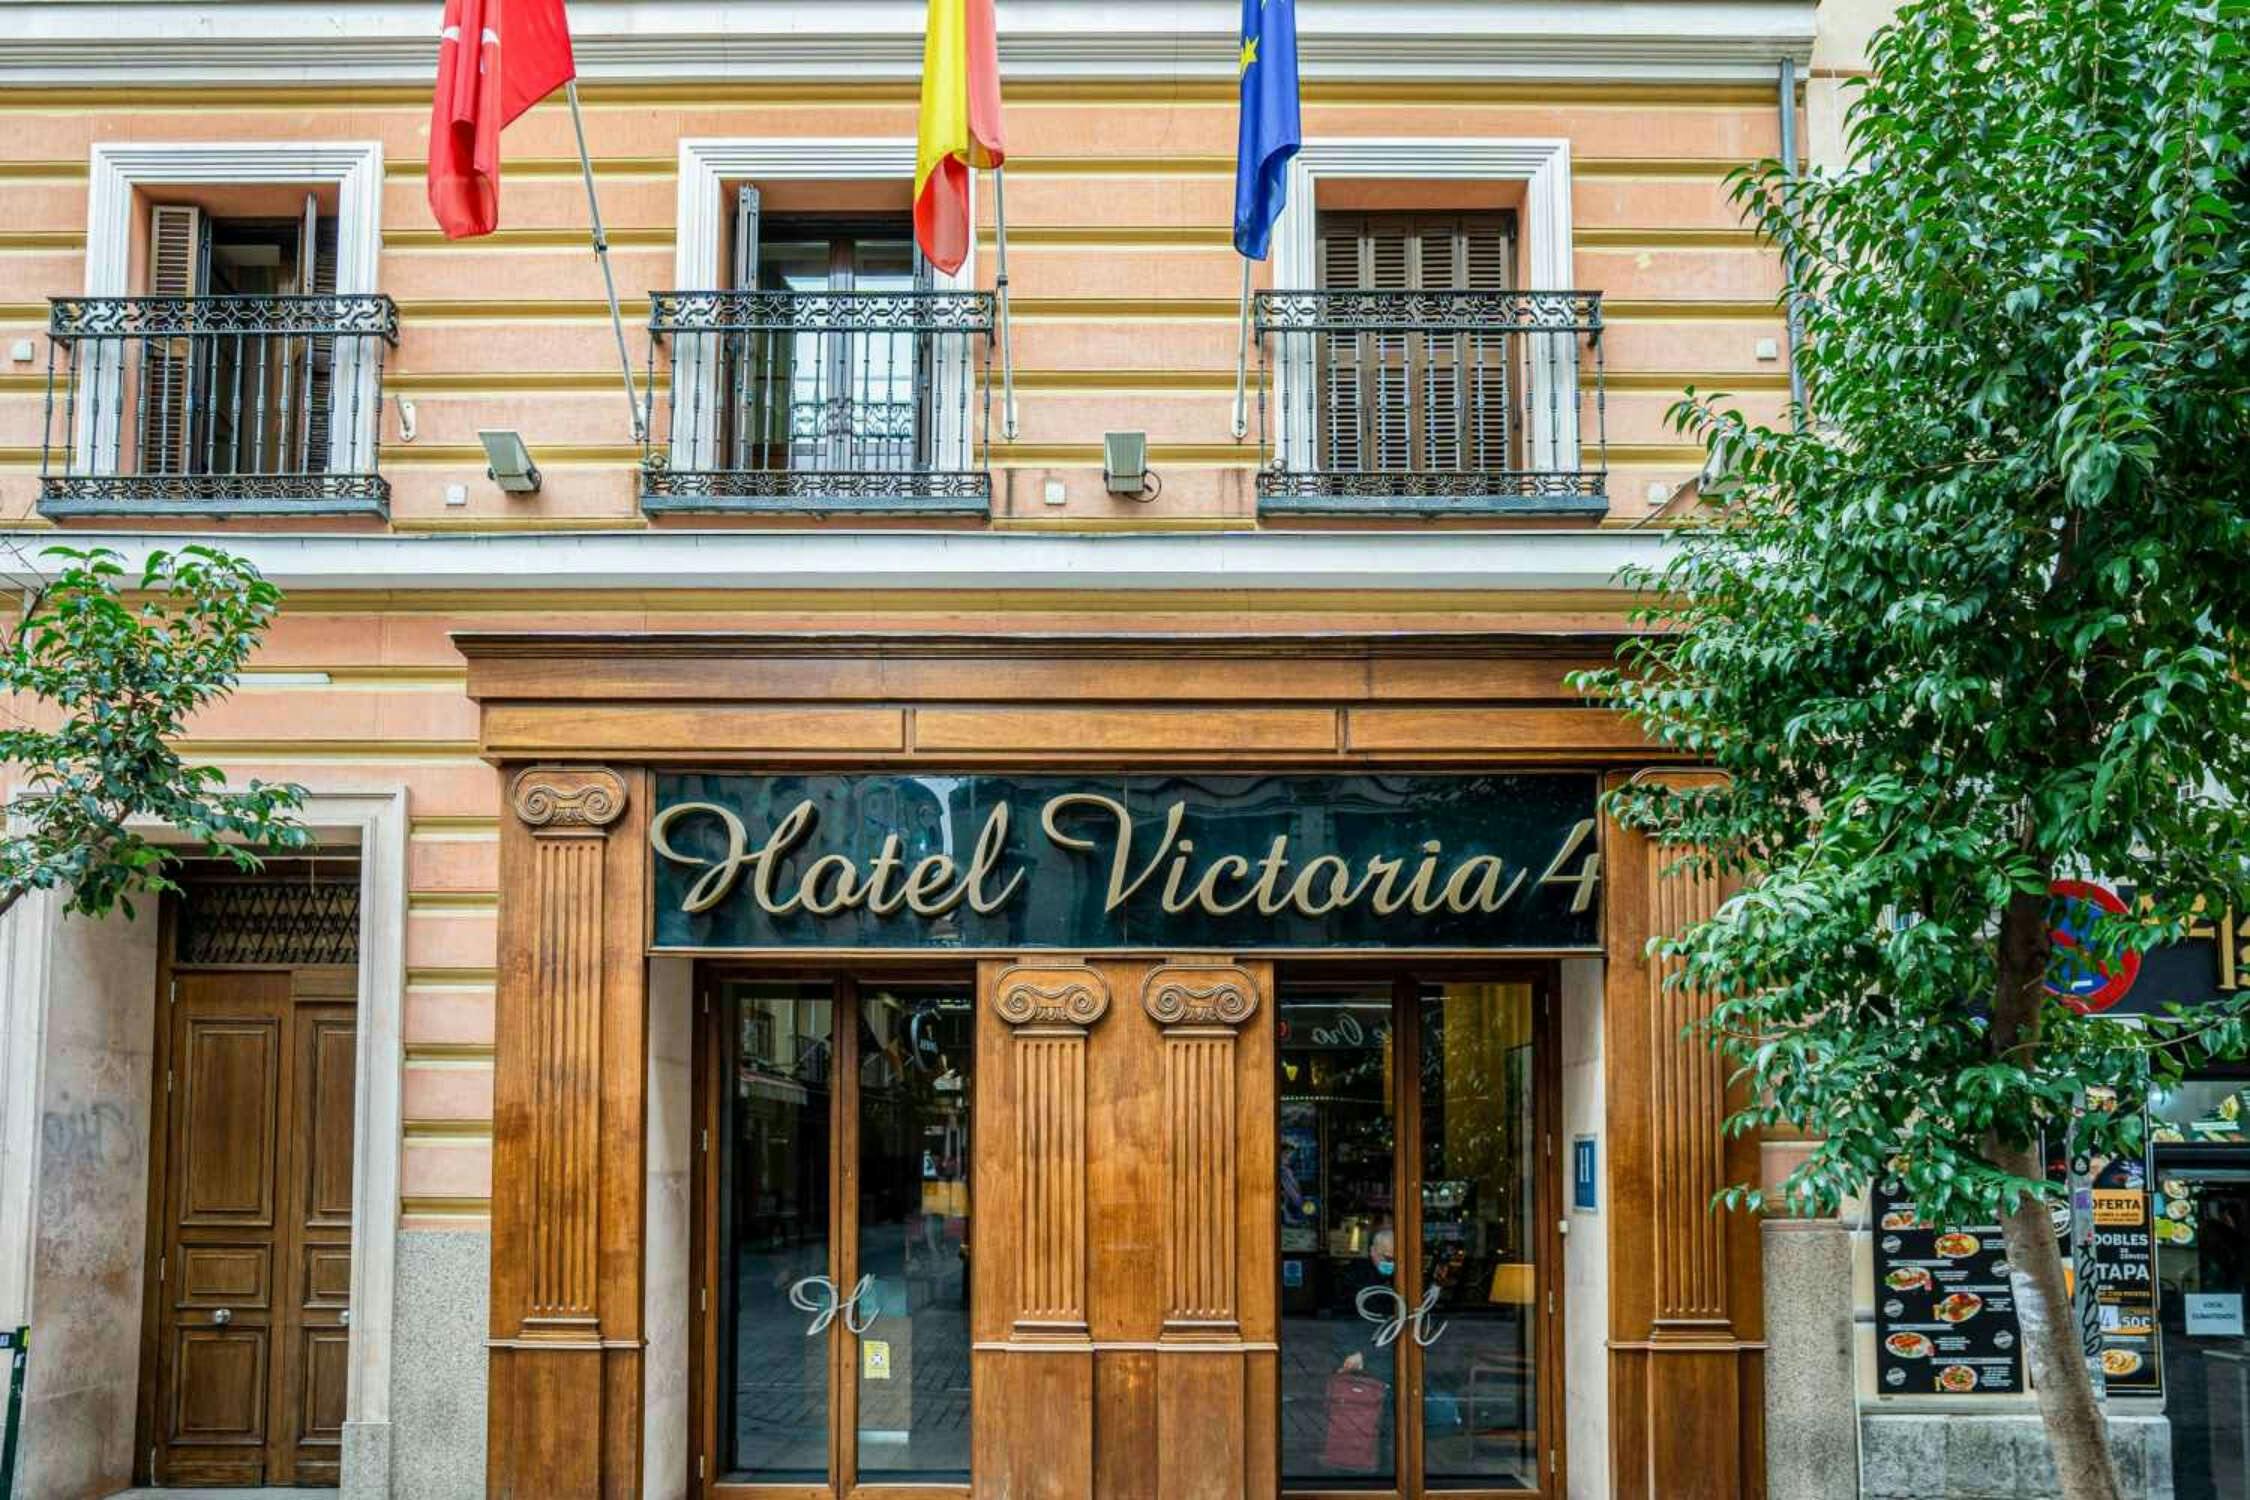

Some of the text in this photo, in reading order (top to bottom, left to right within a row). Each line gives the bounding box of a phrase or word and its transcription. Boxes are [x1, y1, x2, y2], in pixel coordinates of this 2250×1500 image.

[649, 793, 1602, 916] Hotel Victoria 4
[2093, 1233, 2149, 1247] DOBLES
[2096, 1263, 2150, 1281] TAPA
